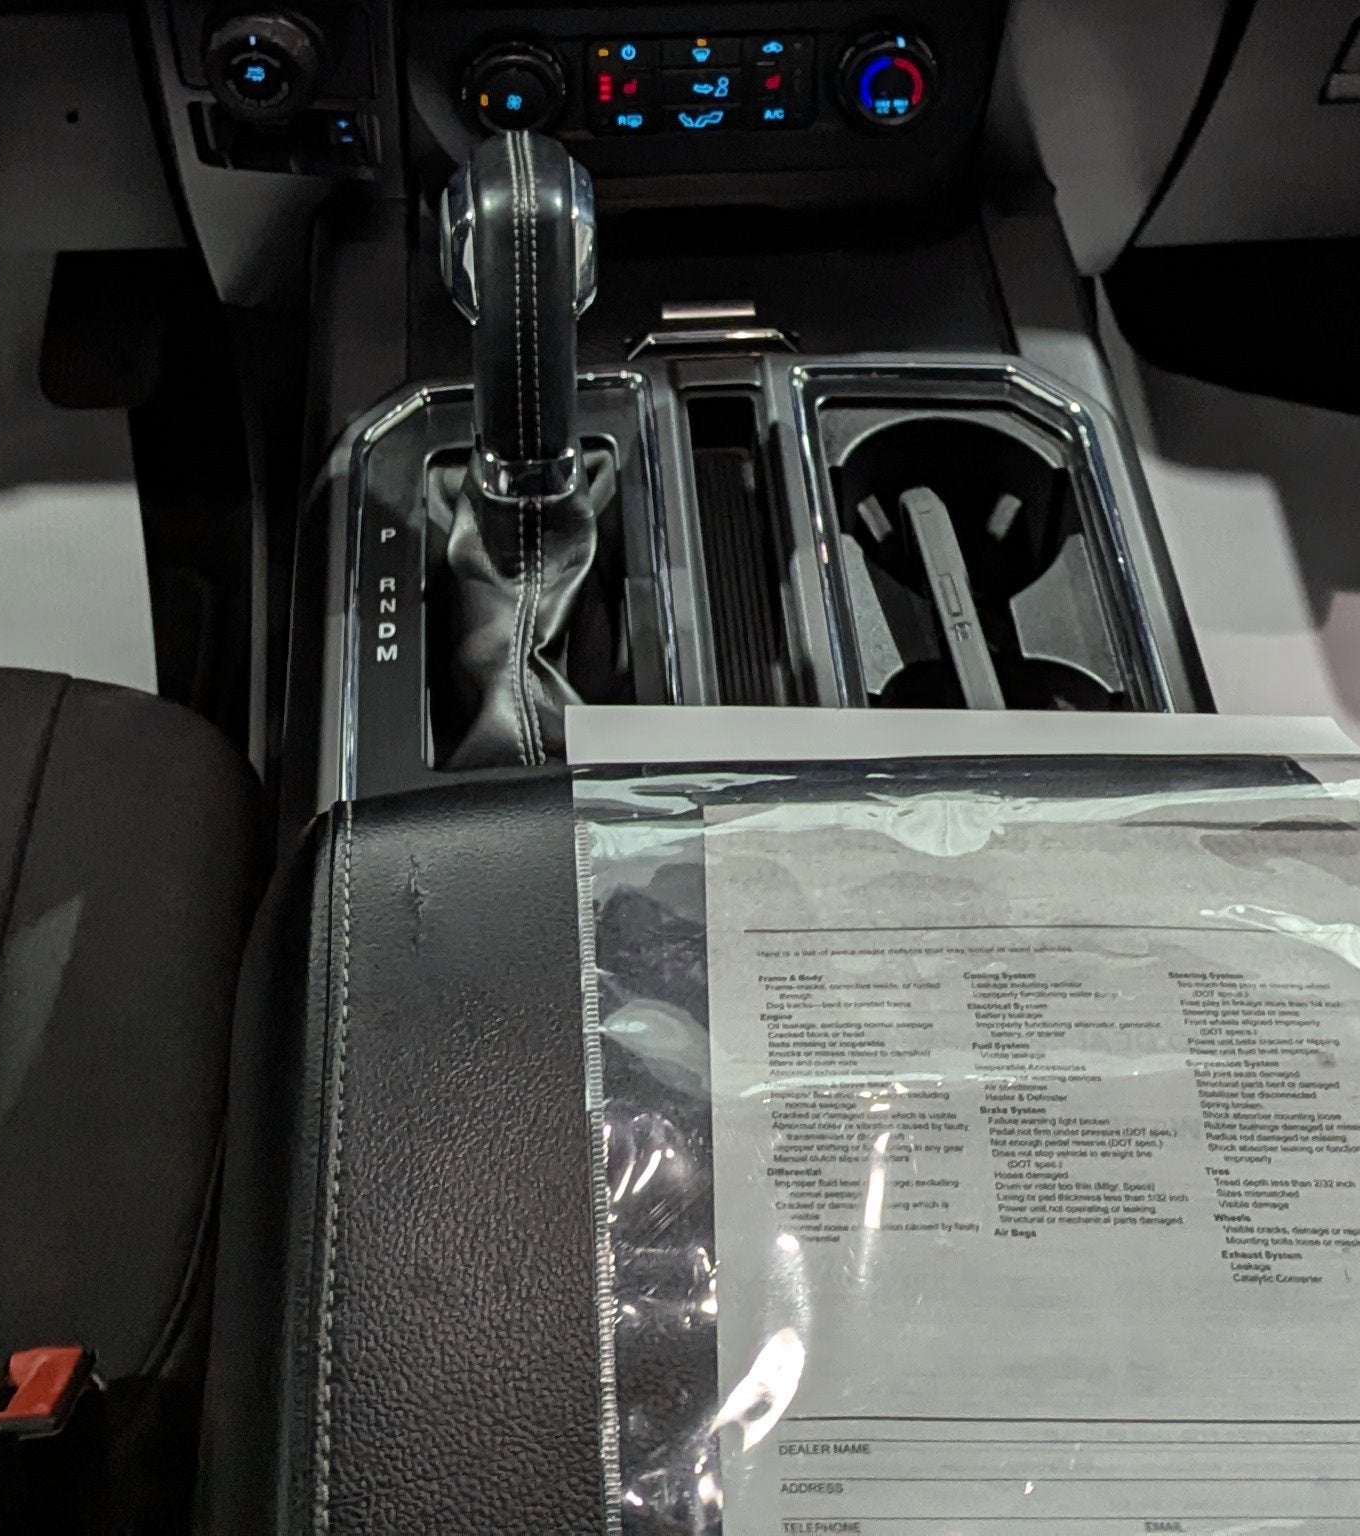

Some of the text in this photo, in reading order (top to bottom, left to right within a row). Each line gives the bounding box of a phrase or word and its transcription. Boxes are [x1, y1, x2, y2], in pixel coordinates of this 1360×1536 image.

[763, 110, 785, 120] A/C
[380, 528, 396, 544] P
[380, 577, 396, 593] R
[380, 598, 396, 614] N
[378, 622, 396, 639] D
[376, 644, 398, 662] M
[758, 974, 788, 983] Frame
[798, 974, 823, 982] Body
[963, 972, 1036, 980] Cooling System
[760, 1014, 792, 1022] Engine
[972, 1042, 1030, 1051] Fuel System
[980, 1106, 1046, 1116] Brake System
[766, 1168, 822, 1177] Differential
[994, 1171, 1069, 1181] Hoses damaged
[1205, 1166, 1230, 1176] Tires
[1214, 1178, 1240, 1187] Tread
[1242, 1179, 1270, 1189] depth
[1270, 1179, 1290, 1188] less
[1291, 1180, 1312, 1188] than
[1336, 1180, 1356, 1188] inch
[1244, 1190, 1300, 1199] mismatched
[1218, 1200, 1290, 1211] Visible damage
[1213, 1214, 1252, 1222] Wheels
[994, 1228, 1036, 1239] Air Bags
[1222, 1224, 1254, 1234] Visible
[1256, 1226, 1290, 1235] cracks,
[1291, 1226, 1330, 1238] damage
[1225, 1236, 1270, 1247] Mounting
[1294, 1238, 1321, 1246] loose
[1222, 1250, 1302, 1261] Exhaust System
[1230, 1262, 1271, 1272] Leakage
[1232, 1274, 1322, 1285] Catalytic Converter
[778, 1443, 872, 1456] DEALER NAME
[780, 1482, 844, 1495] ADDRESS
[782, 1522, 862, 1535] TELEPHONE
[1145, 1520, 1183, 1534] EMAIL
